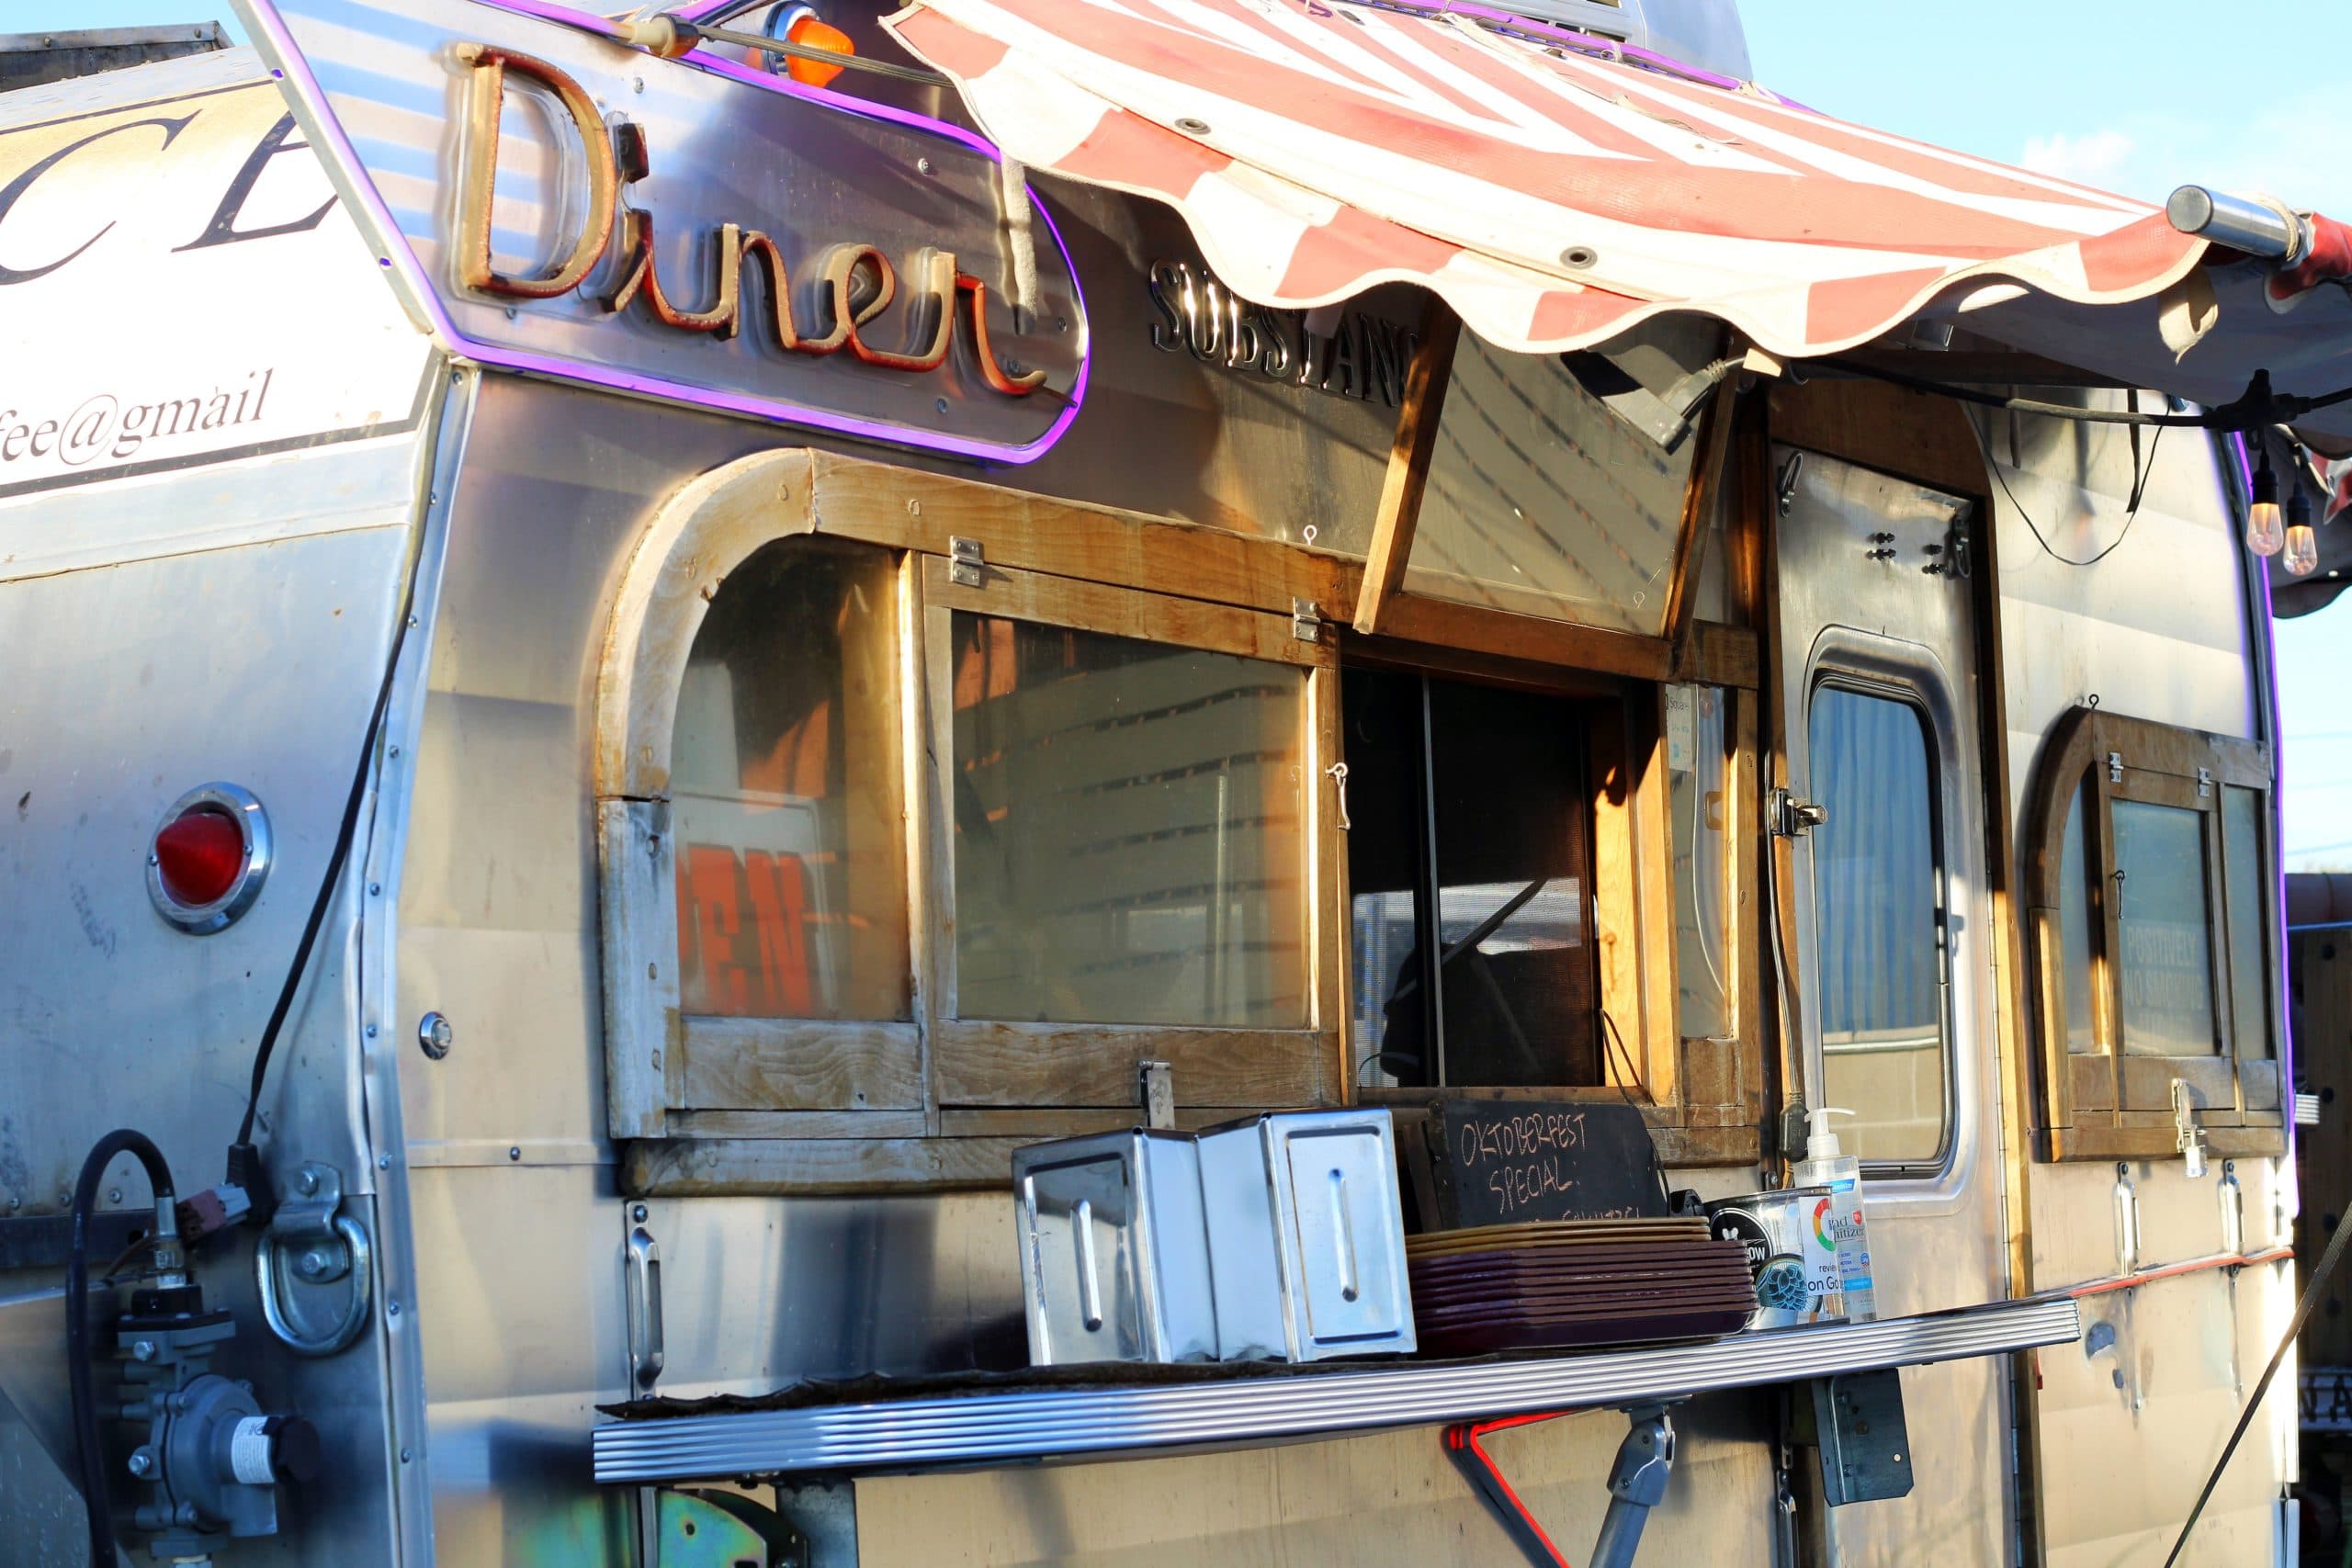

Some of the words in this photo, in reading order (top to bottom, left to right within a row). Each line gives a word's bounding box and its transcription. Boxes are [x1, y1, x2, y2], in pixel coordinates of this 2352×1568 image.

[458, 41, 1046, 397] Diner
[1149, 258, 1419, 408] SUBSTAN
[675, 841, 812, 1013] EN
[2126, 925, 2197, 968] POSITIVELY
[2123, 969, 2143, 1008] NO
[1461, 1112, 1586, 1168] OKTOBERFEST
[1746, 1246, 1765, 1262] OW
[1818, 1262, 1838, 1273] revie
[1807, 1280, 1825, 1292] on
